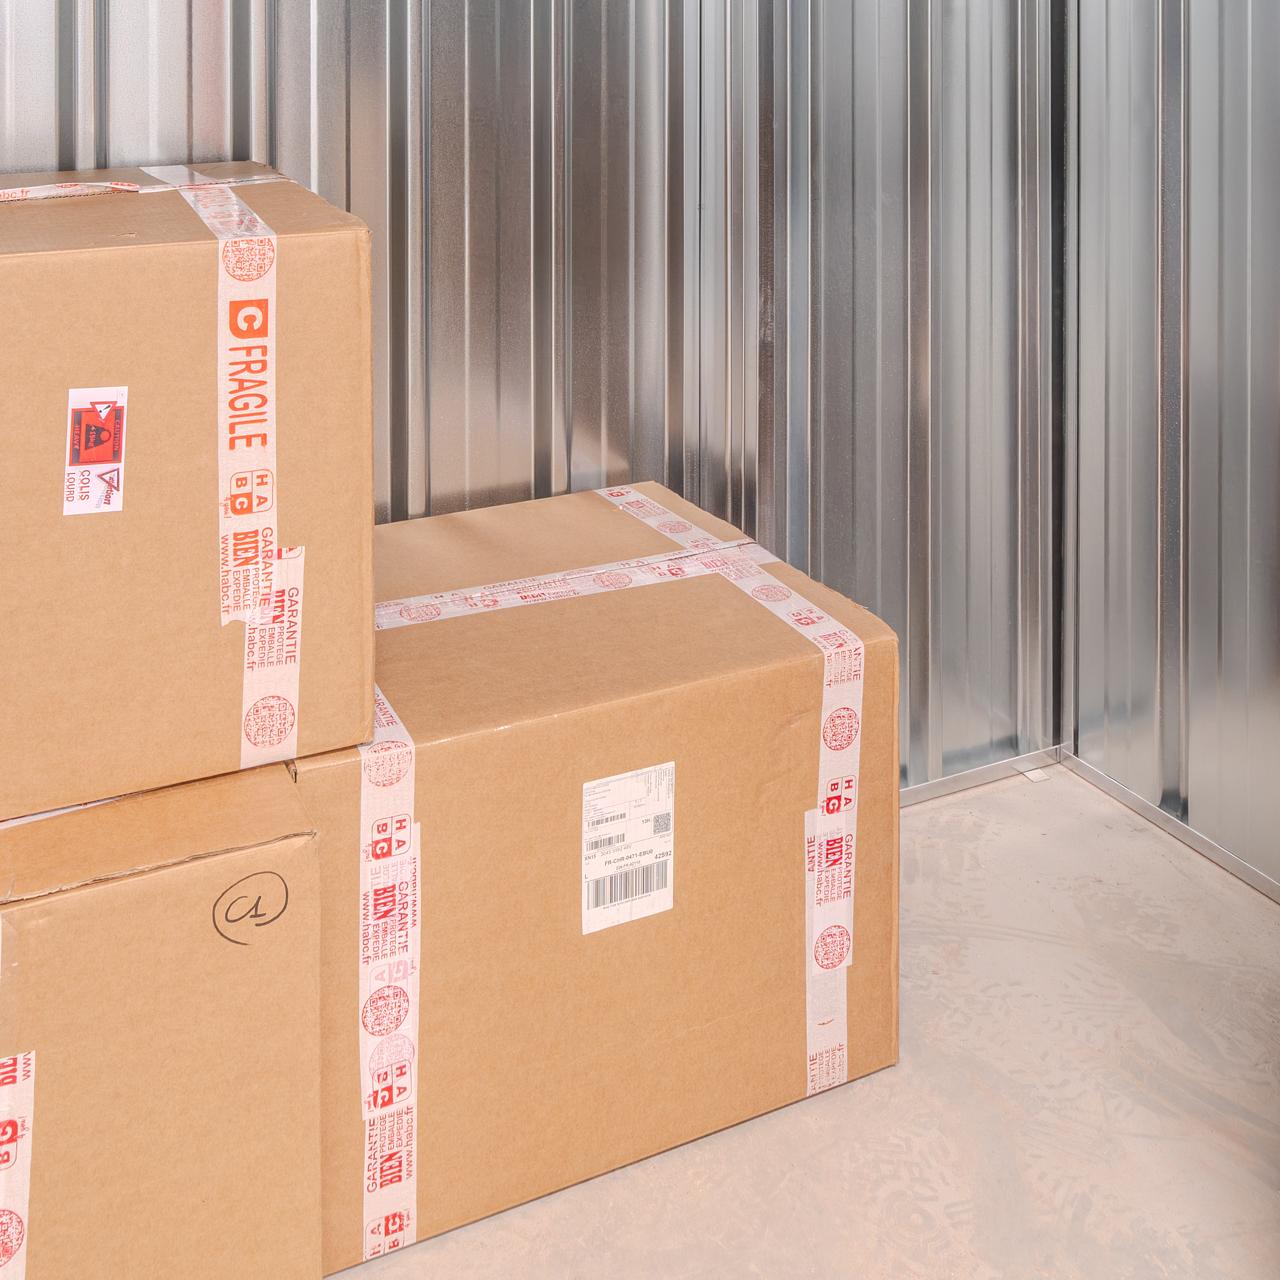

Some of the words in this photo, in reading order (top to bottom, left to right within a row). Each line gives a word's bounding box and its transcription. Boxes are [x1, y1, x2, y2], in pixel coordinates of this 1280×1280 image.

[228, 345, 268, 450] FRAGILE
[66, 472, 76, 502] LOURD
[79, 470, 91, 501] COLIS
[233, 529, 259, 567] BIEN
[221, 535, 231, 616] www.habc.fr
[232, 570, 241, 612] EXPEDIE
[242, 569, 251, 610] EMBALLE
[276, 626, 284, 666] PROTEGE
[285, 587, 299, 664] GARANTIE
[258, 627, 266, 669] EXPEDIE
[267, 627, 275, 668] EMBALLE
[826, 836, 843, 867] BIEN
[843, 834, 854, 898] GARANTIE
[373, 883, 396, 921] BIEN
[397, 881, 409, 954] GARANTIE
[362, 892, 372, 966] www.habc.fr
[372, 923, 380, 962] EXPEDIE
[387, 1111, 396, 1151] EMBALLE
[396, 1109, 404, 1148] EXPEDIE
[404, 1105, 414, 1180] www.habc.fr
[380, 1150, 403, 1189] BIEN
